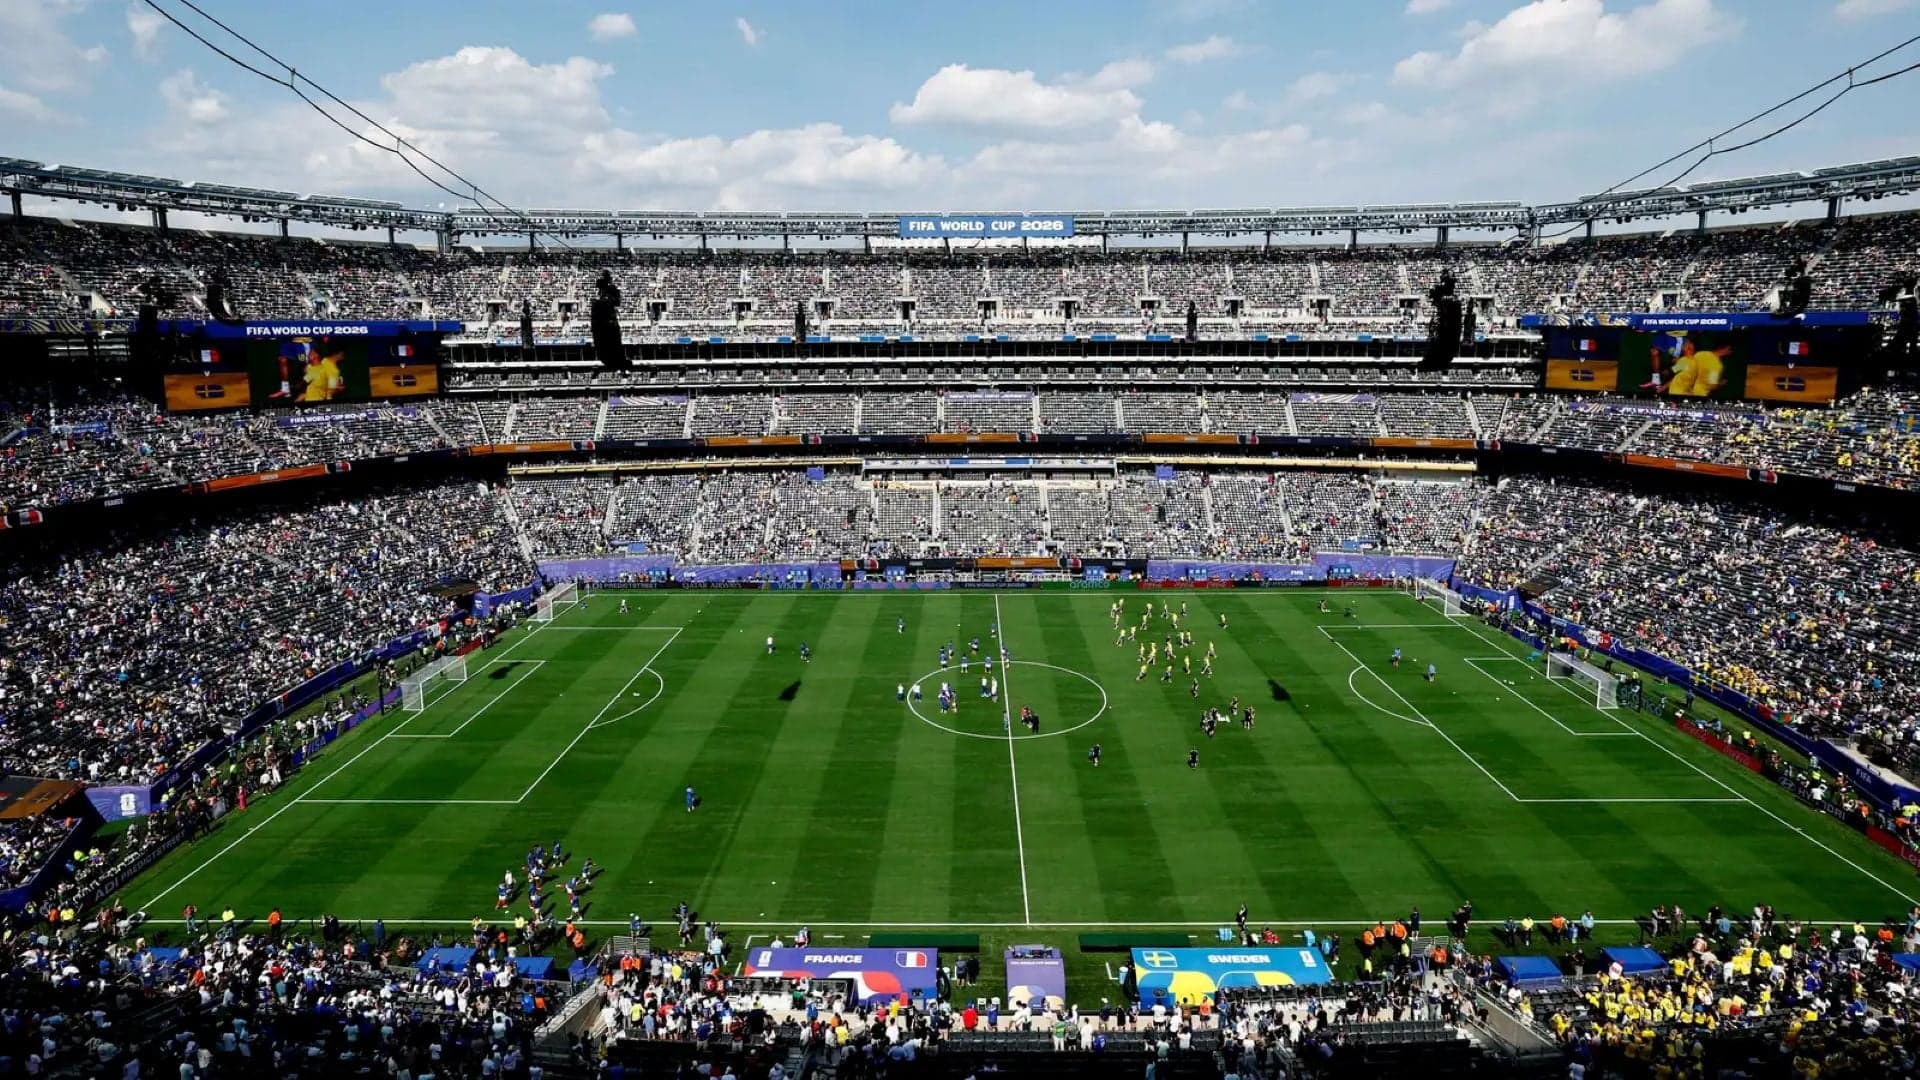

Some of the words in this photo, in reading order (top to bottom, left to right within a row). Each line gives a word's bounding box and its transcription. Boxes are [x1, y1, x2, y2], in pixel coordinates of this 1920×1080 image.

[909, 221, 936, 231] FIFA
[940, 221, 985, 231] WORLD
[991, 221, 1016, 231] CUP
[1021, 221, 1064, 231] 2026
[246, 326, 271, 336] FIFA
[272, 326, 311, 335] WORLD
[312, 326, 333, 335] CUP
[334, 326, 368, 334] 2026
[1069, 578, 1110, 589] aramco
[804, 954, 863, 964] FRANCE
[1208, 954, 1271, 964] SWEDEN
